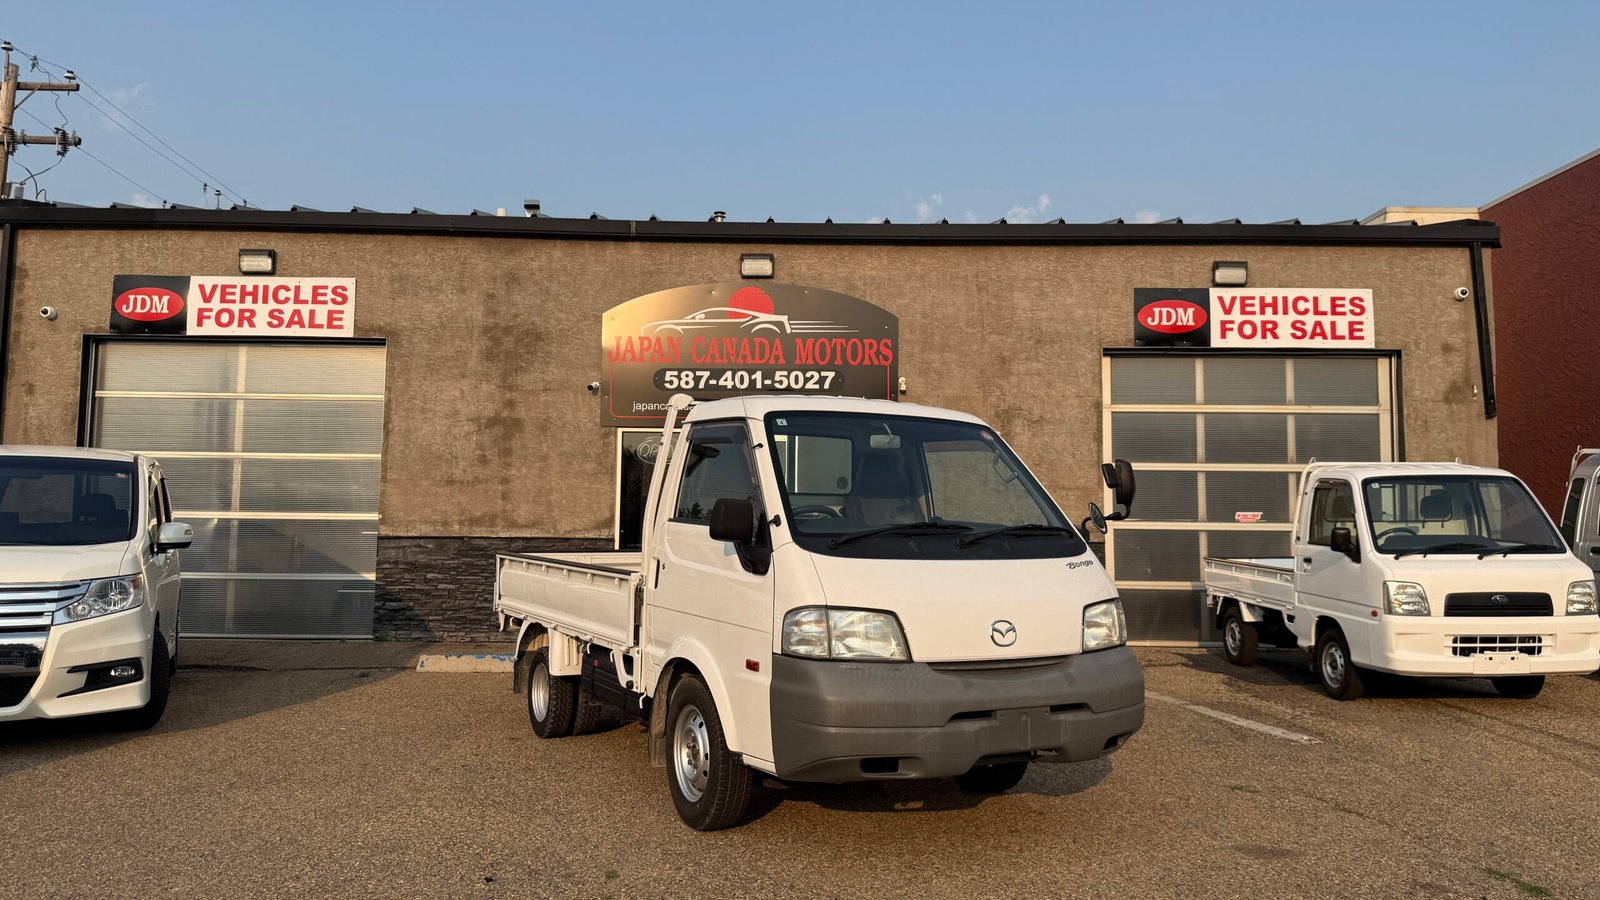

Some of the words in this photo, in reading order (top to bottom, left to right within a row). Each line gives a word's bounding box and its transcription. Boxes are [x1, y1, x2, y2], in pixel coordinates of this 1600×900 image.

[122, 294, 170, 313] JDM
[198, 284, 348, 305] VEHICLES
[1217, 296, 1366, 316] VEHICLES
[196, 308, 257, 329] FOR
[267, 309, 345, 330] SALE
[1147, 307, 1196, 326] JDM
[1220, 320, 1280, 340] FOR
[1290, 320, 1365, 341] SALE
[608, 336, 681, 364] JAPAN
[691, 337, 786, 365] CANADA
[795, 338, 893, 366] MOTORS
[664, 370, 836, 390] 587-401-5027
[1066, 560, 1094, 570] Bongo
